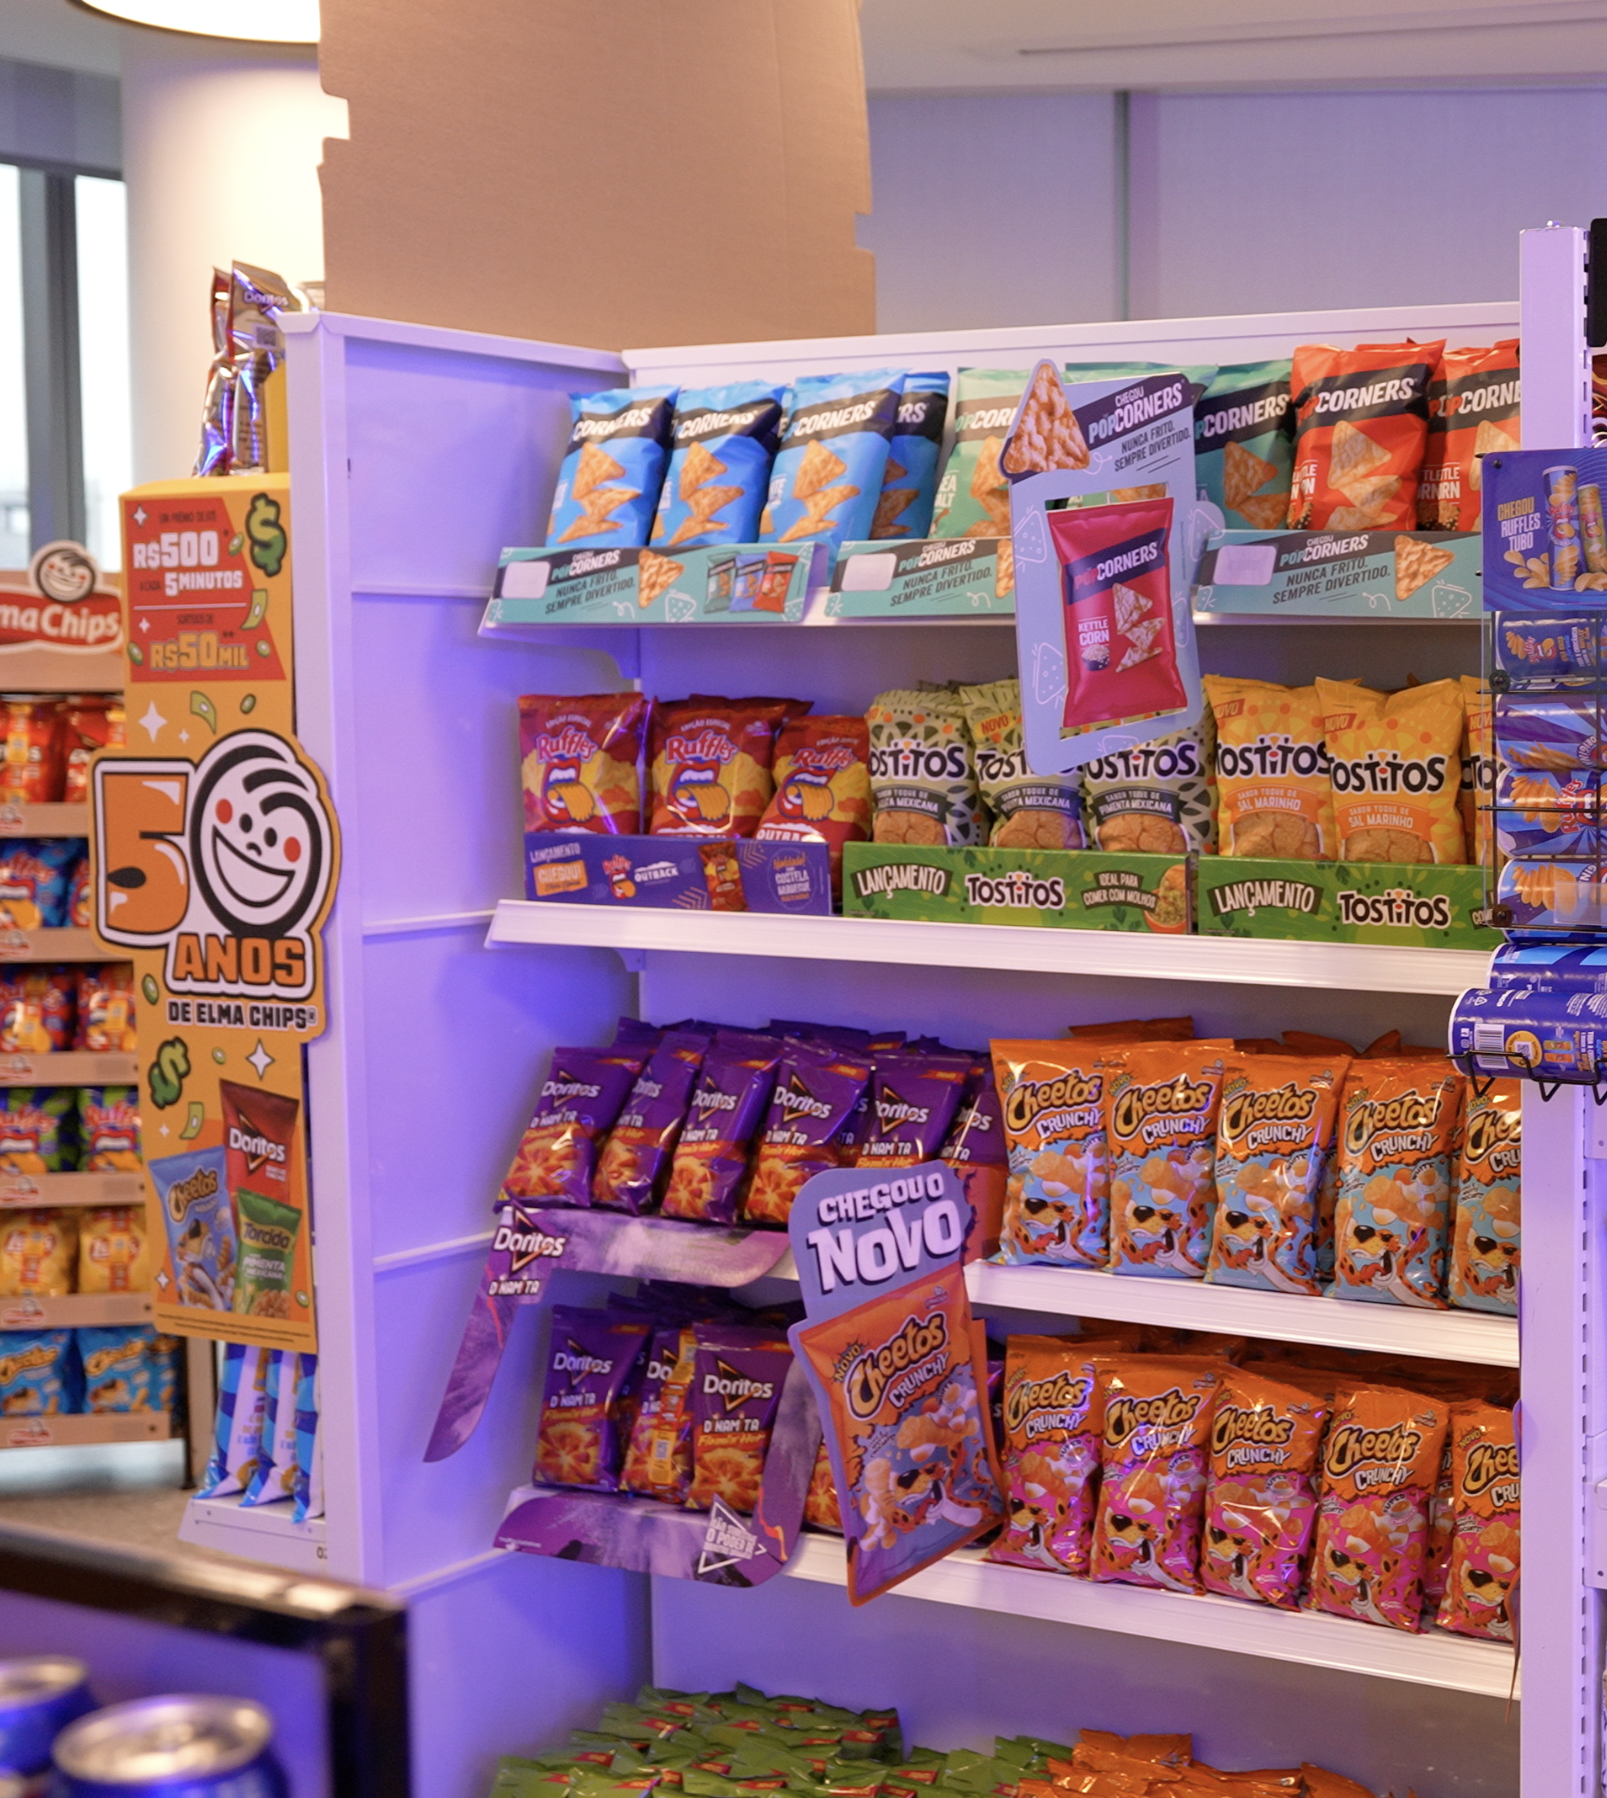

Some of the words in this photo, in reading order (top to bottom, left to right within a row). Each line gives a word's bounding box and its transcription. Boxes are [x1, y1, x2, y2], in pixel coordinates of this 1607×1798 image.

[1115, 386, 1145, 407] CHEGOU
[1114, 452, 1147, 473] SEMPRE
[1149, 427, 1192, 456] DIVERTIDO.
[1121, 431, 1149, 454] NUNCA
[1150, 419, 1176, 439] FRITO.
[1497, 496, 1536, 522] CHEGOU
[1500, 512, 1542, 539] RUFFLES
[132, 530, 219, 571] R$500
[1508, 532, 1534, 552] TUBO
[164, 572, 179, 597] 5
[178, 570, 243, 590] MINUTOS
[556, 578, 588, 598] NUNCA
[590, 569, 619, 586] FRITO.
[890, 585, 933, 607] SEMPRE
[935, 566, 993, 594] DIVERTIDO.
[903, 569, 939, 590] NUNCA
[941, 560, 974, 578] FRITO.
[1272, 586, 1322, 605] SEMPRE
[1325, 564, 1392, 592] DIVERTIDO.
[1286, 567, 1328, 588] NUNCA
[1331, 556, 1369, 575] FRITO.
[545, 595, 582, 615] SEMPRE
[584, 576, 636, 599] DIVERTIDO.
[0, 604, 119, 643] maChips
[1078, 618, 1109, 633] KETTLE
[1079, 629, 1111, 646] CORN
[980, 711, 1011, 736] NOVO
[1324, 714, 1350, 732] NOVO
[536, 725, 599, 766] Ruffles
[665, 728, 740, 766] Ruffles
[1330, 755, 1447, 794] TOSTITOS
[1030, 796, 1071, 811] MEXICANA
[1104, 790, 1127, 801] SABOR
[1131, 799, 1173, 814] MEXICANA
[1237, 799, 1254, 812] SAL
[1254, 798, 1302, 812] MARINHO
[1349, 805, 1370, 817] SABOR
[1372, 804, 1398, 815] TOQUE
[1400, 805, 1410, 815] DE
[1348, 815, 1365, 829] SAL
[1366, 815, 1414, 829] MARINHO
[530, 842, 582, 863] LANÇAMENTO
[634, 866, 680, 883] OUTBACK
[857, 864, 947, 900] LANÇAMENTO
[1099, 872, 1119, 887] IDEAL
[1120, 874, 1140, 888] PARA
[966, 873, 1065, 909] TOSTITOS
[1083, 890, 1110, 907] COMER
[1110, 890, 1128, 904] COM
[1127, 892, 1157, 910] MOLHOS
[1214, 879, 1315, 917] LANÇAMENTO
[1340, 892, 1451, 928] TOSTITOS
[172, 931, 308, 989] ANOS
[168, 1001, 192, 1022] DE
[196, 1003, 246, 1026] ELMA
[541, 1080, 600, 1098] Doritos
[1005, 1068, 1103, 1135] Cheetos
[1222, 1077, 1247, 1098] NOVO
[773, 1086, 833, 1120] Doritos
[1112, 1072, 1216, 1141] Cheetos
[1220, 1081, 1318, 1148] Cheetos
[1036, 1107, 1103, 1139] CRUNCHY
[1141, 1115, 1211, 1144] CRUNCHY
[1344, 1087, 1442, 1156] Cheetos
[228, 1127, 287, 1162] Doritos
[1246, 1124, 1313, 1150] CRUNCHY
[1370, 1132, 1439, 1162] CRUNCHY
[168, 1167, 218, 1223] Cheetos
[818, 1175, 923, 1226] CHEGOU
[923, 1172, 946, 1199] O
[240, 1221, 292, 1250] Torcida
[493, 1227, 566, 1257] Doritos
[807, 1200, 965, 1293] NOVO
[242, 1254, 286, 1272] PIMENTA
[552, 1351, 613, 1375] Doritos
[835, 1343, 863, 1384] NOVO
[844, 1310, 948, 1421] Cheetos
[702, 1373, 774, 1399] Doritos
[888, 1352, 951, 1410] CRUNCHY
[1005, 1370, 1090, 1430] Cheetos
[1025, 1411, 1087, 1439] CRUNCHY
[1104, 1386, 1203, 1449] Cheetos
[1211, 1406, 1295, 1457] Cheetos
[1131, 1423, 1198, 1456] CRUNCHY
[1325, 1423, 1422, 1480] Cheetos
[1226, 1446, 1293, 1468] CRUNCHY
[1264, 1473, 1292, 1493] SUPER
[1353, 1464, 1416, 1492] CRUNCHY
[1382, 1492, 1408, 1515] SUPER
